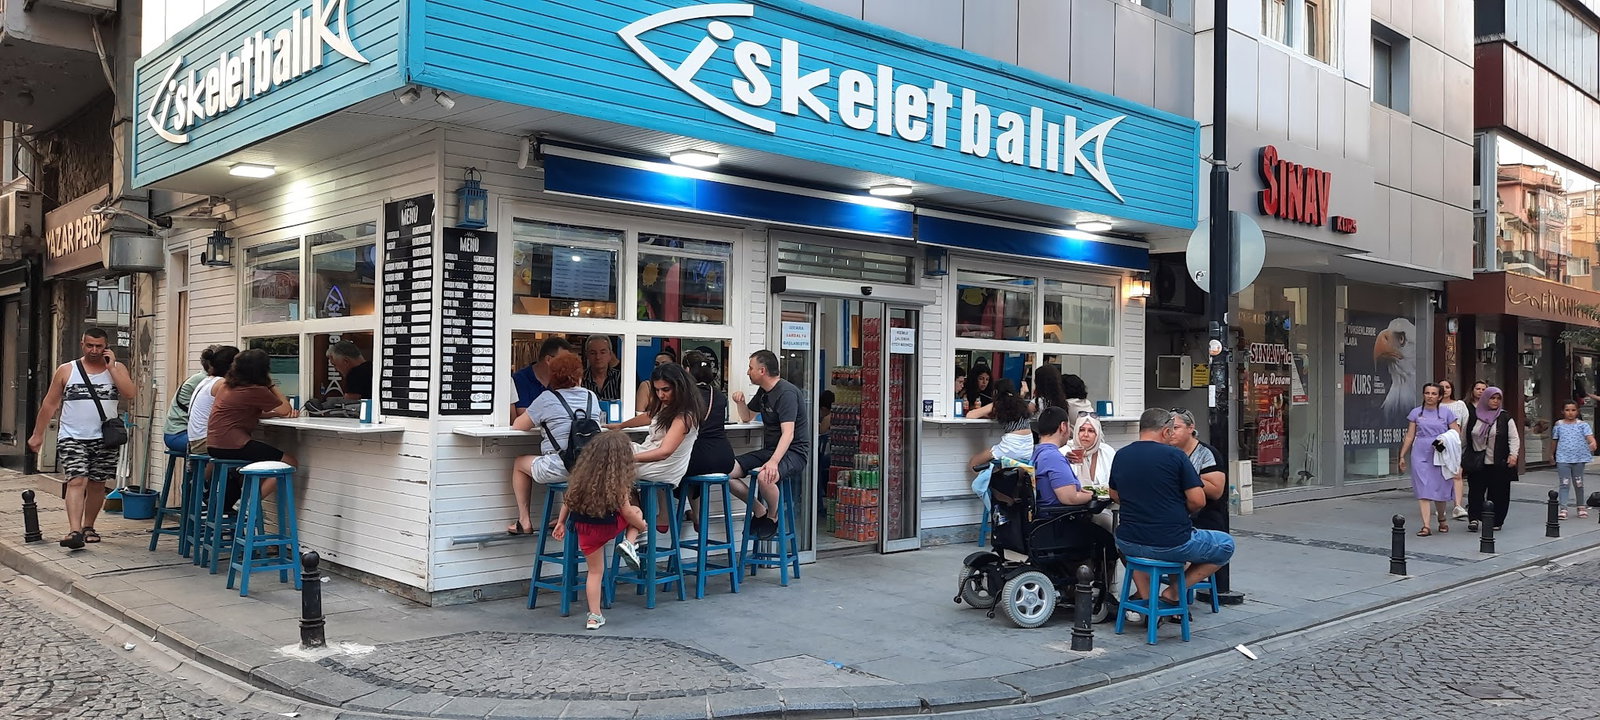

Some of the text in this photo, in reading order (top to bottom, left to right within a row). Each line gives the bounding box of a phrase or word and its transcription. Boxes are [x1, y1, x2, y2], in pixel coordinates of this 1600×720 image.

[1258, 144, 1331, 226] SINAV
[401, 204, 418, 226] MENÜ
[1334, 216, 1357, 233] KURS
[46, 221, 75, 260] YAZAR
[460, 237, 479, 252] MENÜ
[1253, 372, 1291, 387] Yola Devam
[1351, 374, 1372, 395] KURS
